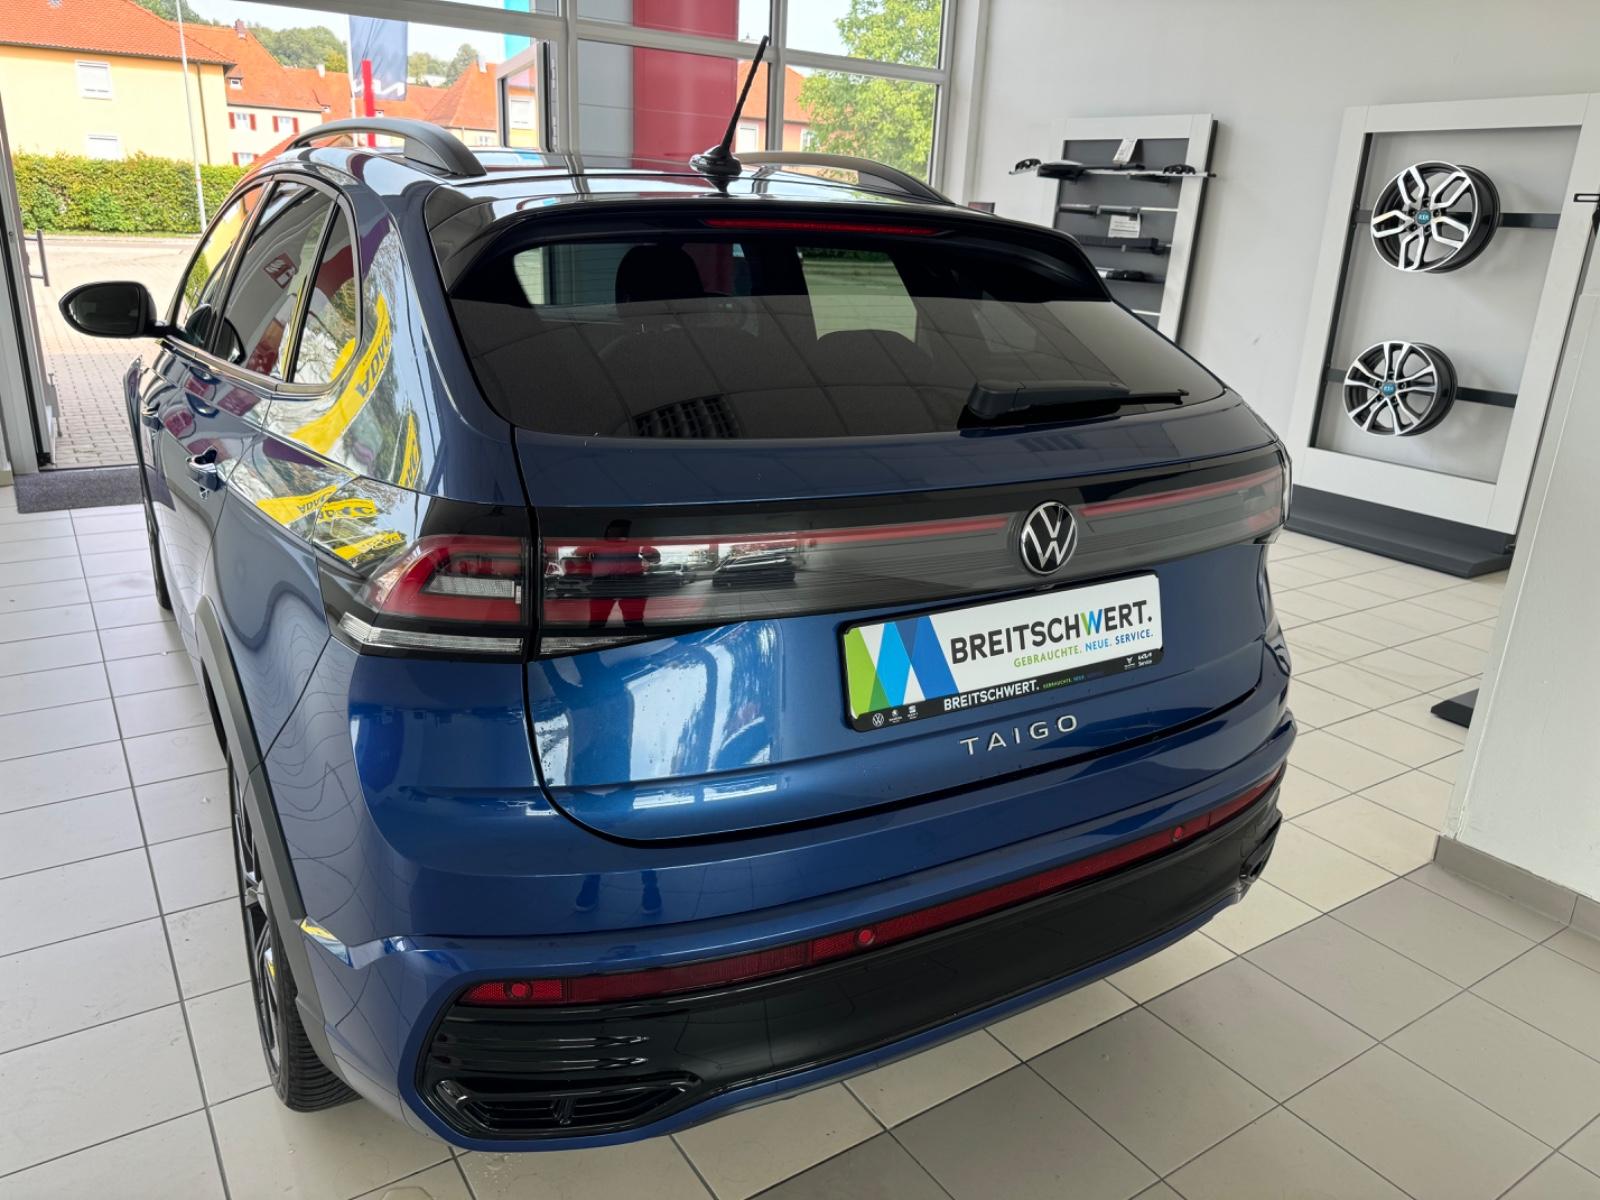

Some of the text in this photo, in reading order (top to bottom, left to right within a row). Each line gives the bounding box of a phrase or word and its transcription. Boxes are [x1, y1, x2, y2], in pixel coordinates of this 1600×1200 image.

[949, 600, 1153, 665] BREITSCHWERT.
[1013, 628, 1153, 668] GEBRAUCHTE. NEUE. SERVICE.
[943, 679, 1040, 711] BREITSCHWERT.
[959, 714, 1078, 755] TAIGO
